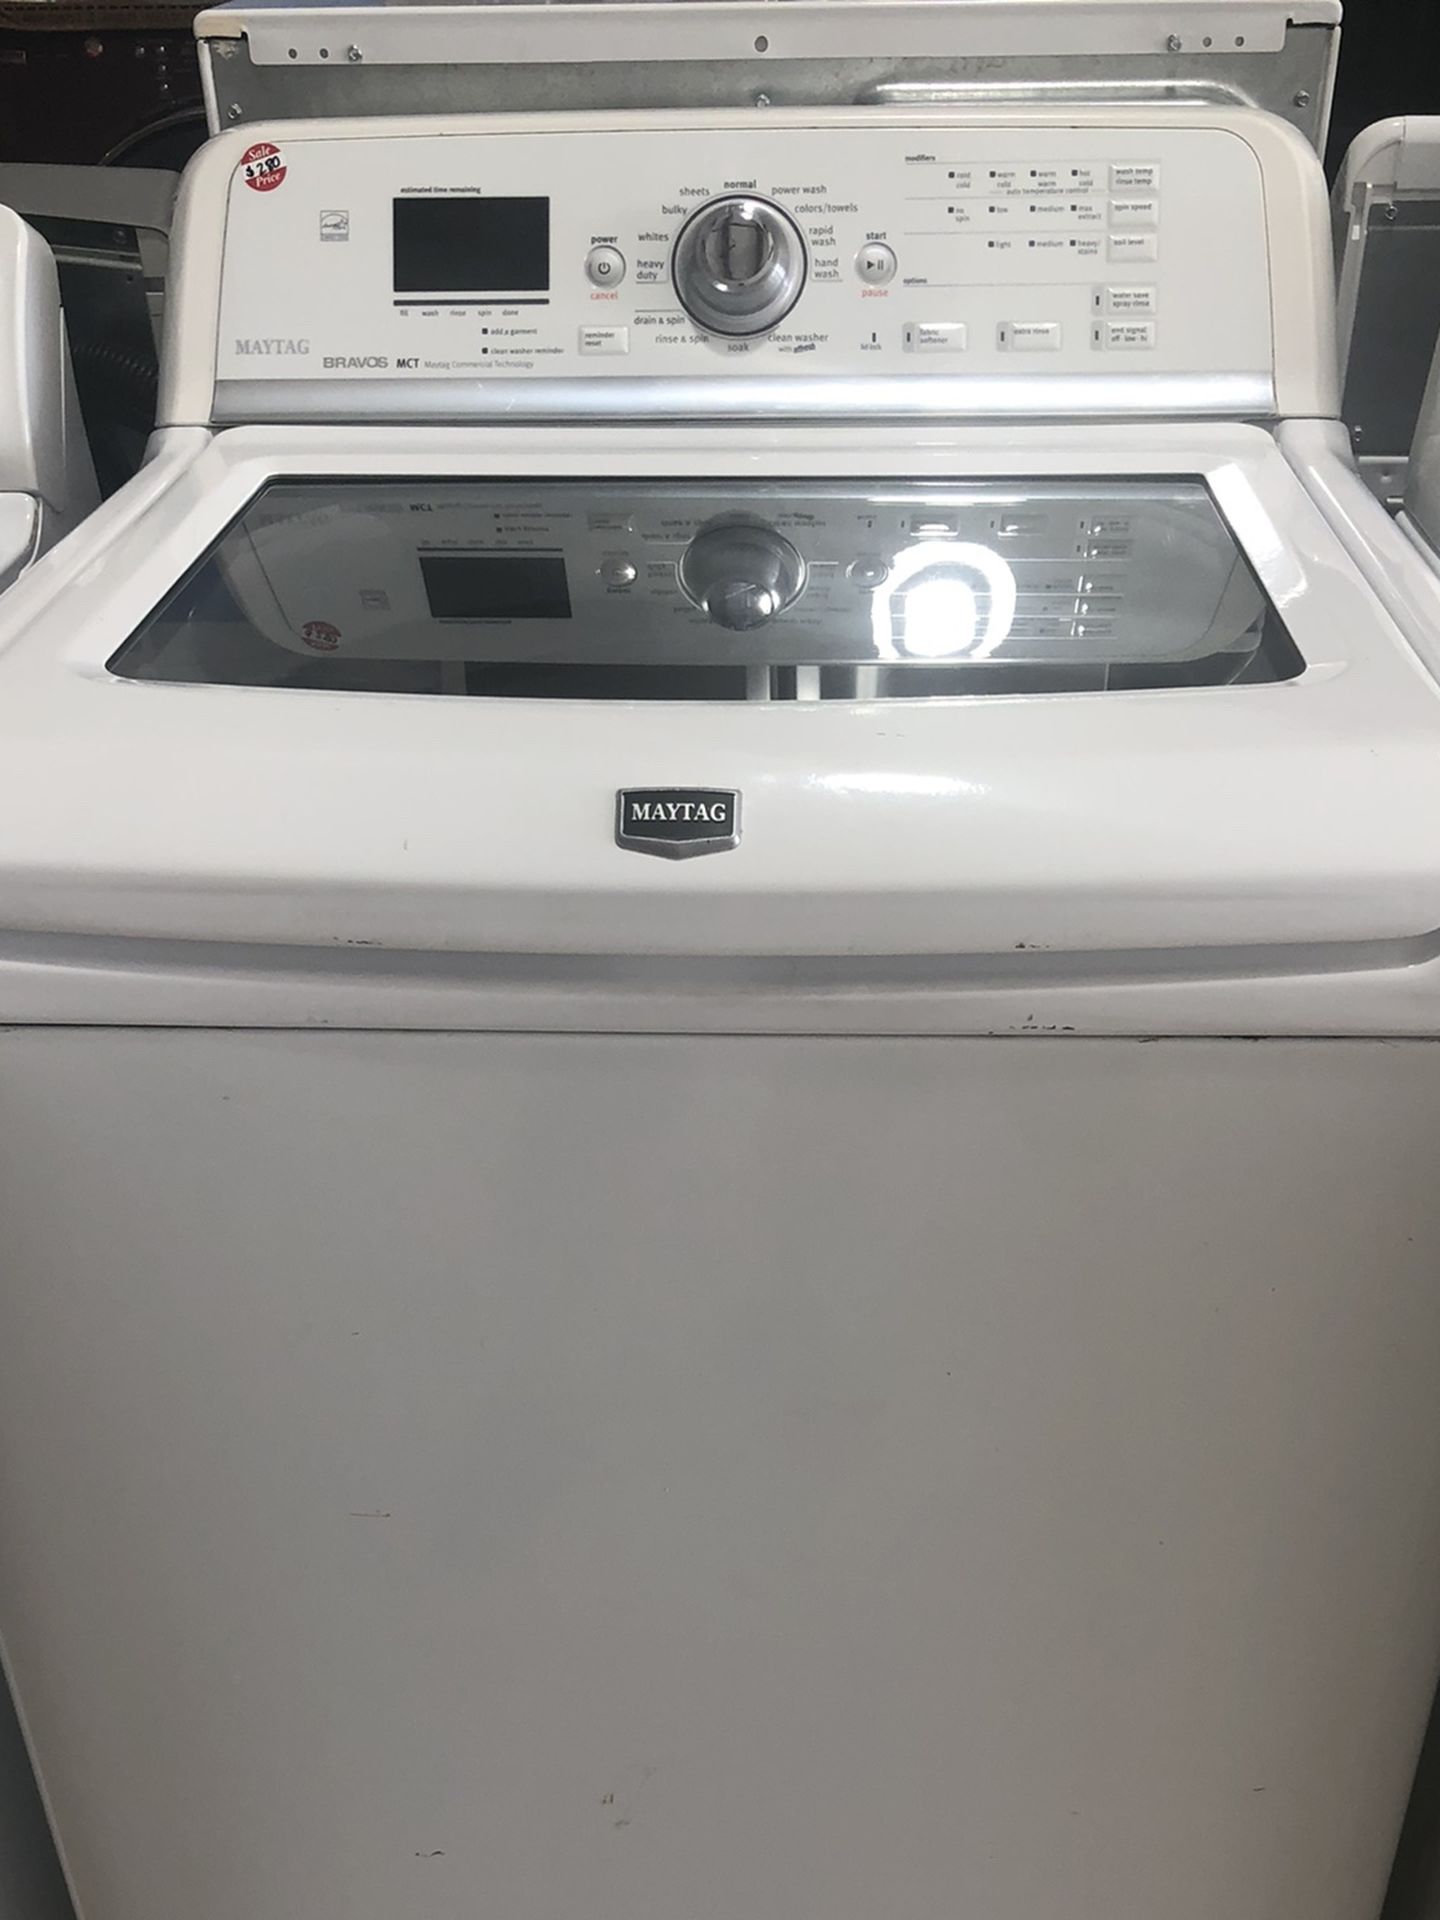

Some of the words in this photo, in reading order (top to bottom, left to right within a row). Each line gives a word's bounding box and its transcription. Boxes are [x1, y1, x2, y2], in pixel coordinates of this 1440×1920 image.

[248, 145, 271, 160] Sale
[256, 173, 280, 187] Price
[723, 180, 757, 189] normal
[449, 186, 481, 194] remaining
[679, 186, 710, 196] sheets
[771, 187, 800, 196] power
[802, 185, 827, 194] wash
[661, 205, 688, 215] bulky
[794, 203, 859, 214] colors/towels
[1131, 203, 1151, 212] speed
[808, 226, 834, 236] rapid
[590, 236, 618, 245] power
[638, 232, 669, 242] whites
[811, 237, 836, 246] wash
[866, 232, 887, 241] start
[636, 260, 665, 270] heavy
[814, 258, 839, 267] hand
[636, 271, 658, 280] duty
[814, 269, 839, 278] wash
[903, 277, 927, 285] options
[590, 291, 619, 300] cancel
[862, 288, 889, 298] pause
[1112, 300, 1131, 308] spray
[634, 315, 657, 325] drain
[666, 315, 686, 326] spin
[510, 328, 537, 336] garment
[655, 335, 678, 343] rinse
[689, 334, 710, 345] spin
[768, 333, 793, 342] clean
[794, 333, 829, 342] washer
[919, 336, 948, 344] softener
[235, 339, 310, 355] MAYTAG
[727, 342, 750, 352] soak
[323, 356, 388, 369] BRAVOS
[396, 358, 420, 369] MCT
[424, 361, 450, 370] Maytag
[452, 360, 492, 369] Commercial
[494, 360, 534, 370] Technology
[631, 802, 726, 821] MAYTAG
